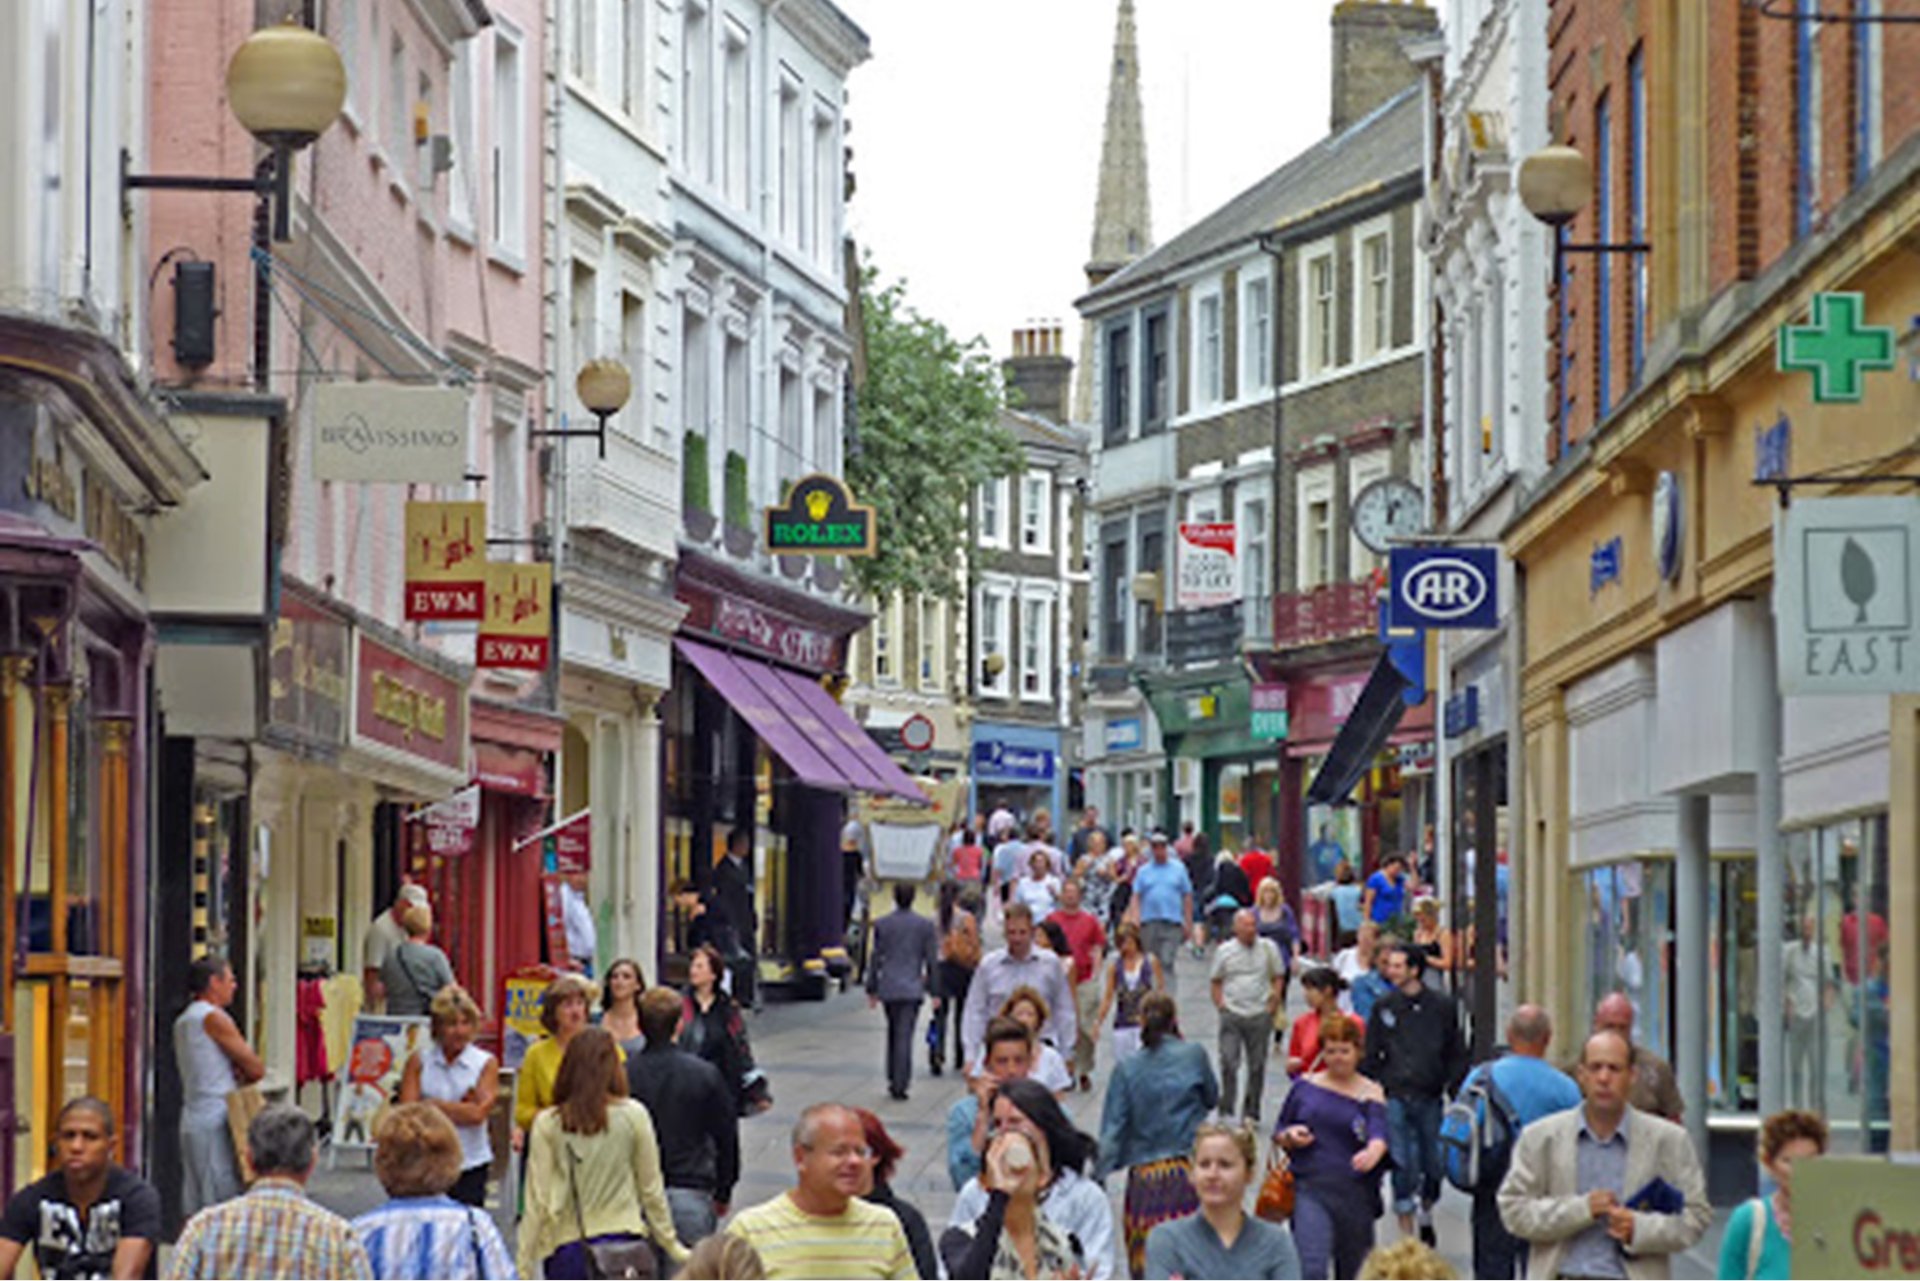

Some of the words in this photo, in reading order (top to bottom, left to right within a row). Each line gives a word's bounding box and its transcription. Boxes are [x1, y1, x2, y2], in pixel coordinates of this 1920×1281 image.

[773, 522, 863, 545] ROLEX
[413, 591, 477, 612] EWM
[483, 640, 541, 661] EWM
[1806, 635, 1911, 676] EAST
